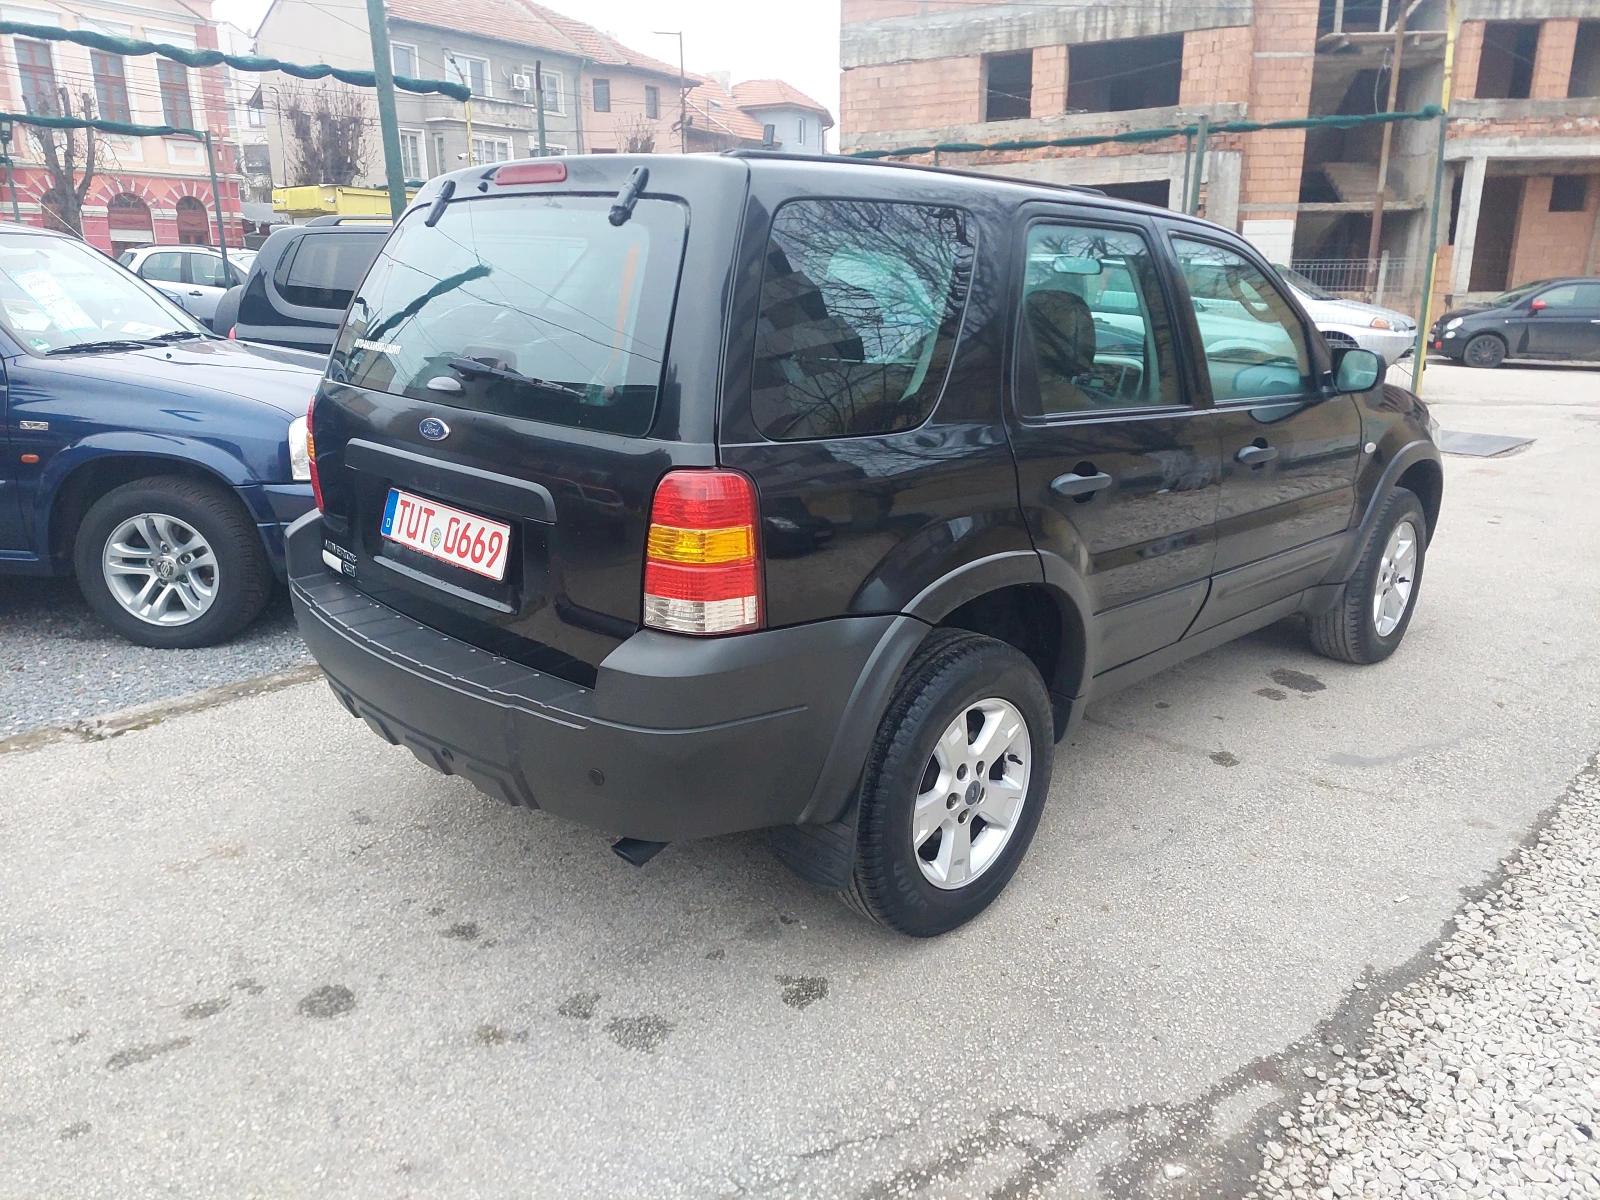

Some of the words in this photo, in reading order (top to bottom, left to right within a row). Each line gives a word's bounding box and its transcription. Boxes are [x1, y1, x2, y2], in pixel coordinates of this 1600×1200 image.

[423, 421, 441, 436] Ford
[385, 517, 391, 528] D
[398, 499, 436, 544] TUT
[443, 516, 504, 569] 0669
